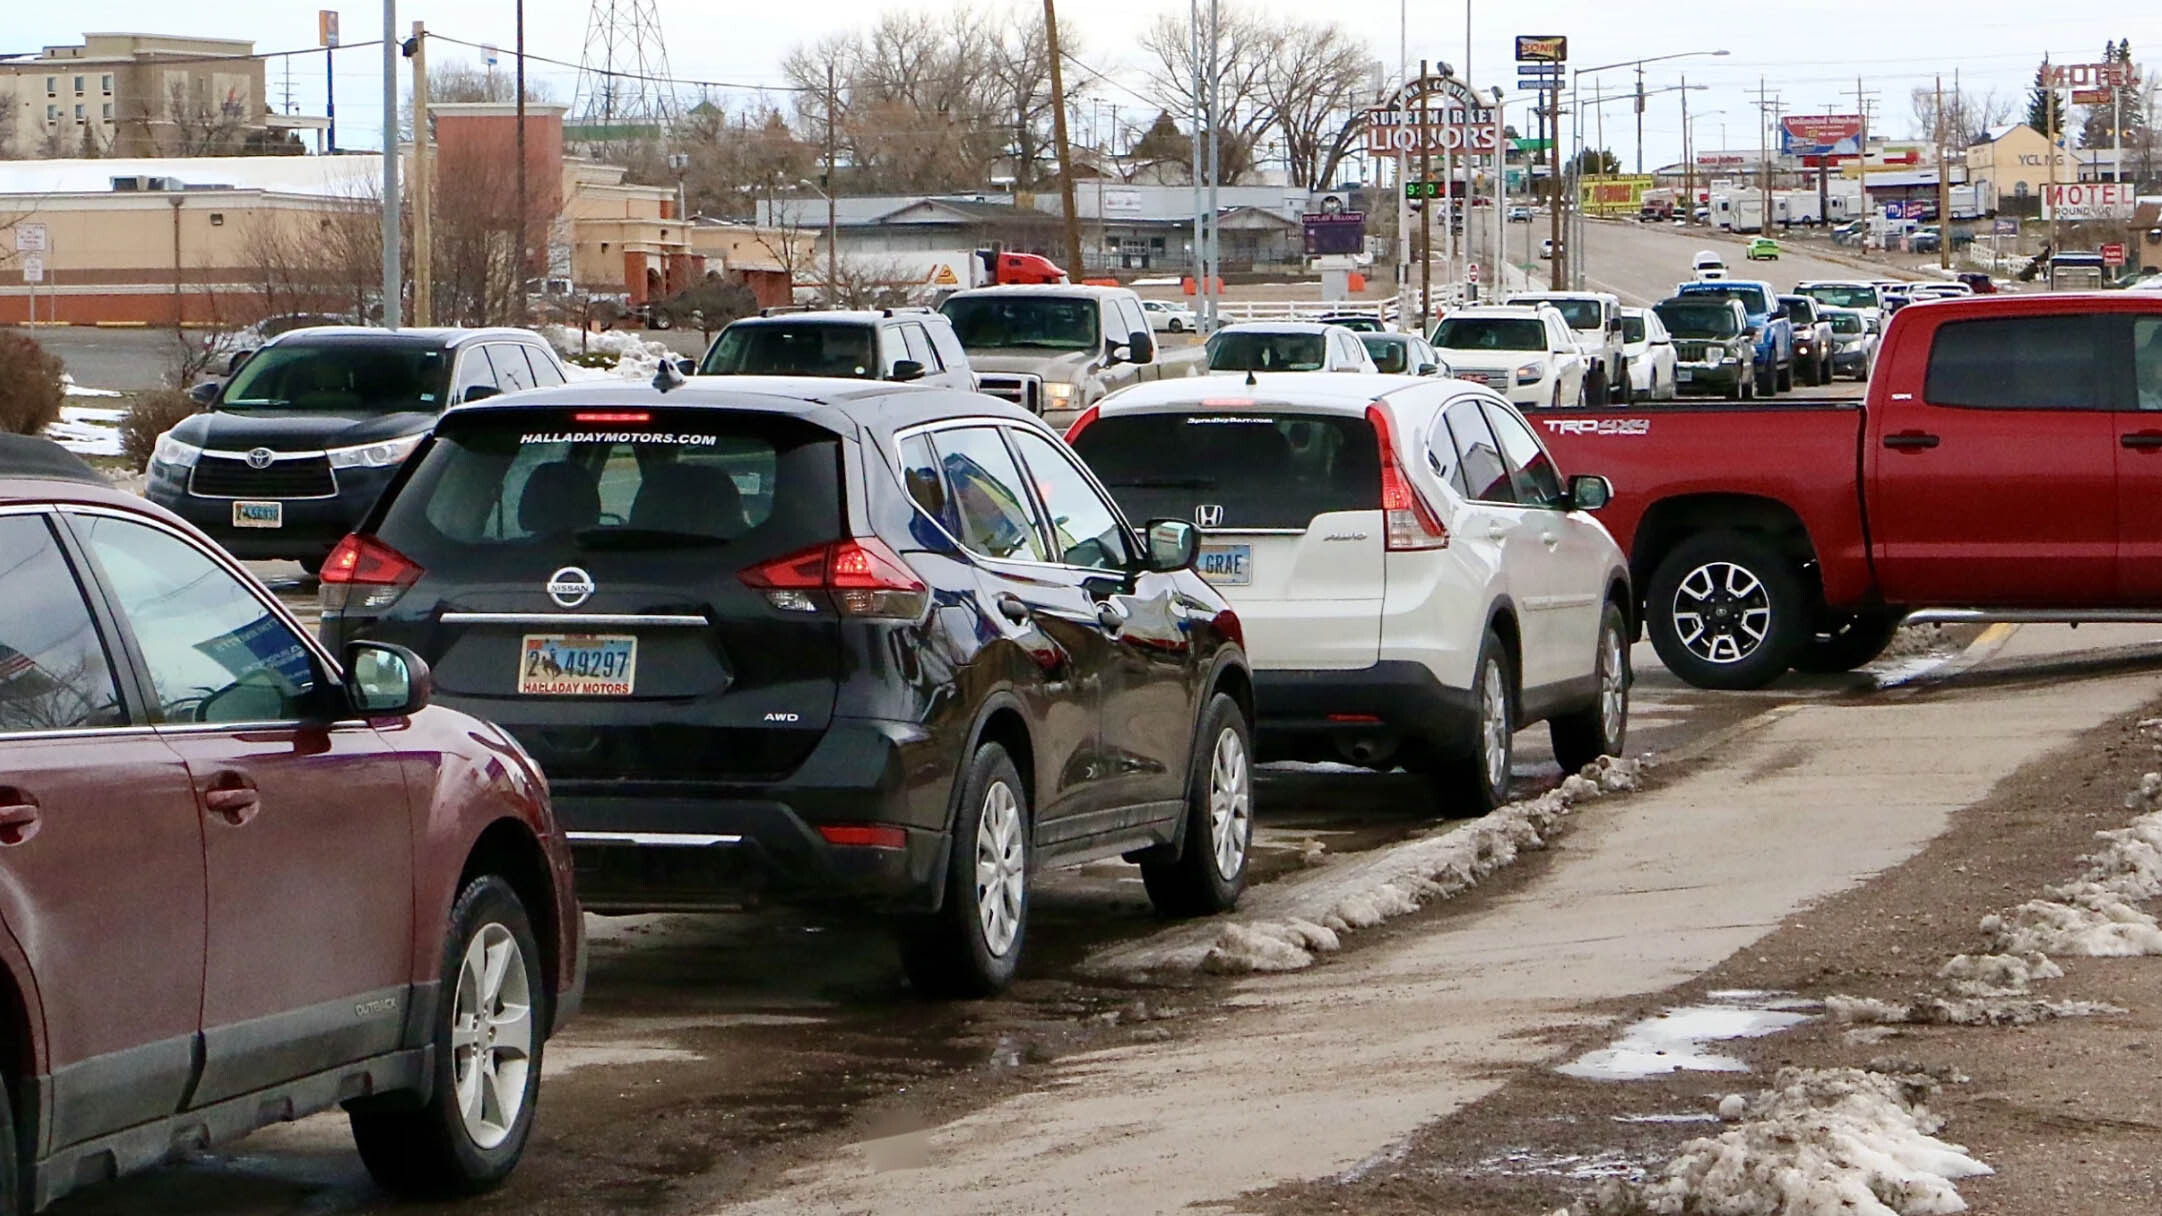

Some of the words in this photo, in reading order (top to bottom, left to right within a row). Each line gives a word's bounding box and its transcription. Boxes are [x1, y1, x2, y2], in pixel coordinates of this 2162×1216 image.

[2041, 63, 2141, 86] MOTEL
[1371, 127, 1496, 152] LIQUORS
[1407, 184, 1435, 196] 9:0
[2046, 184, 2134, 206] MOTEL
[519, 432, 717, 446] HALLADAYMOTORS.COM
[1206, 554, 1243, 575] GRAE
[551, 584, 589, 592] NISSAN
[527, 650, 540, 678] 2
[565, 651, 628, 678] 49297
[523, 682, 580, 694] HALLADAY
[582, 682, 629, 694] MOTORS
[764, 713, 799, 722] AWD
